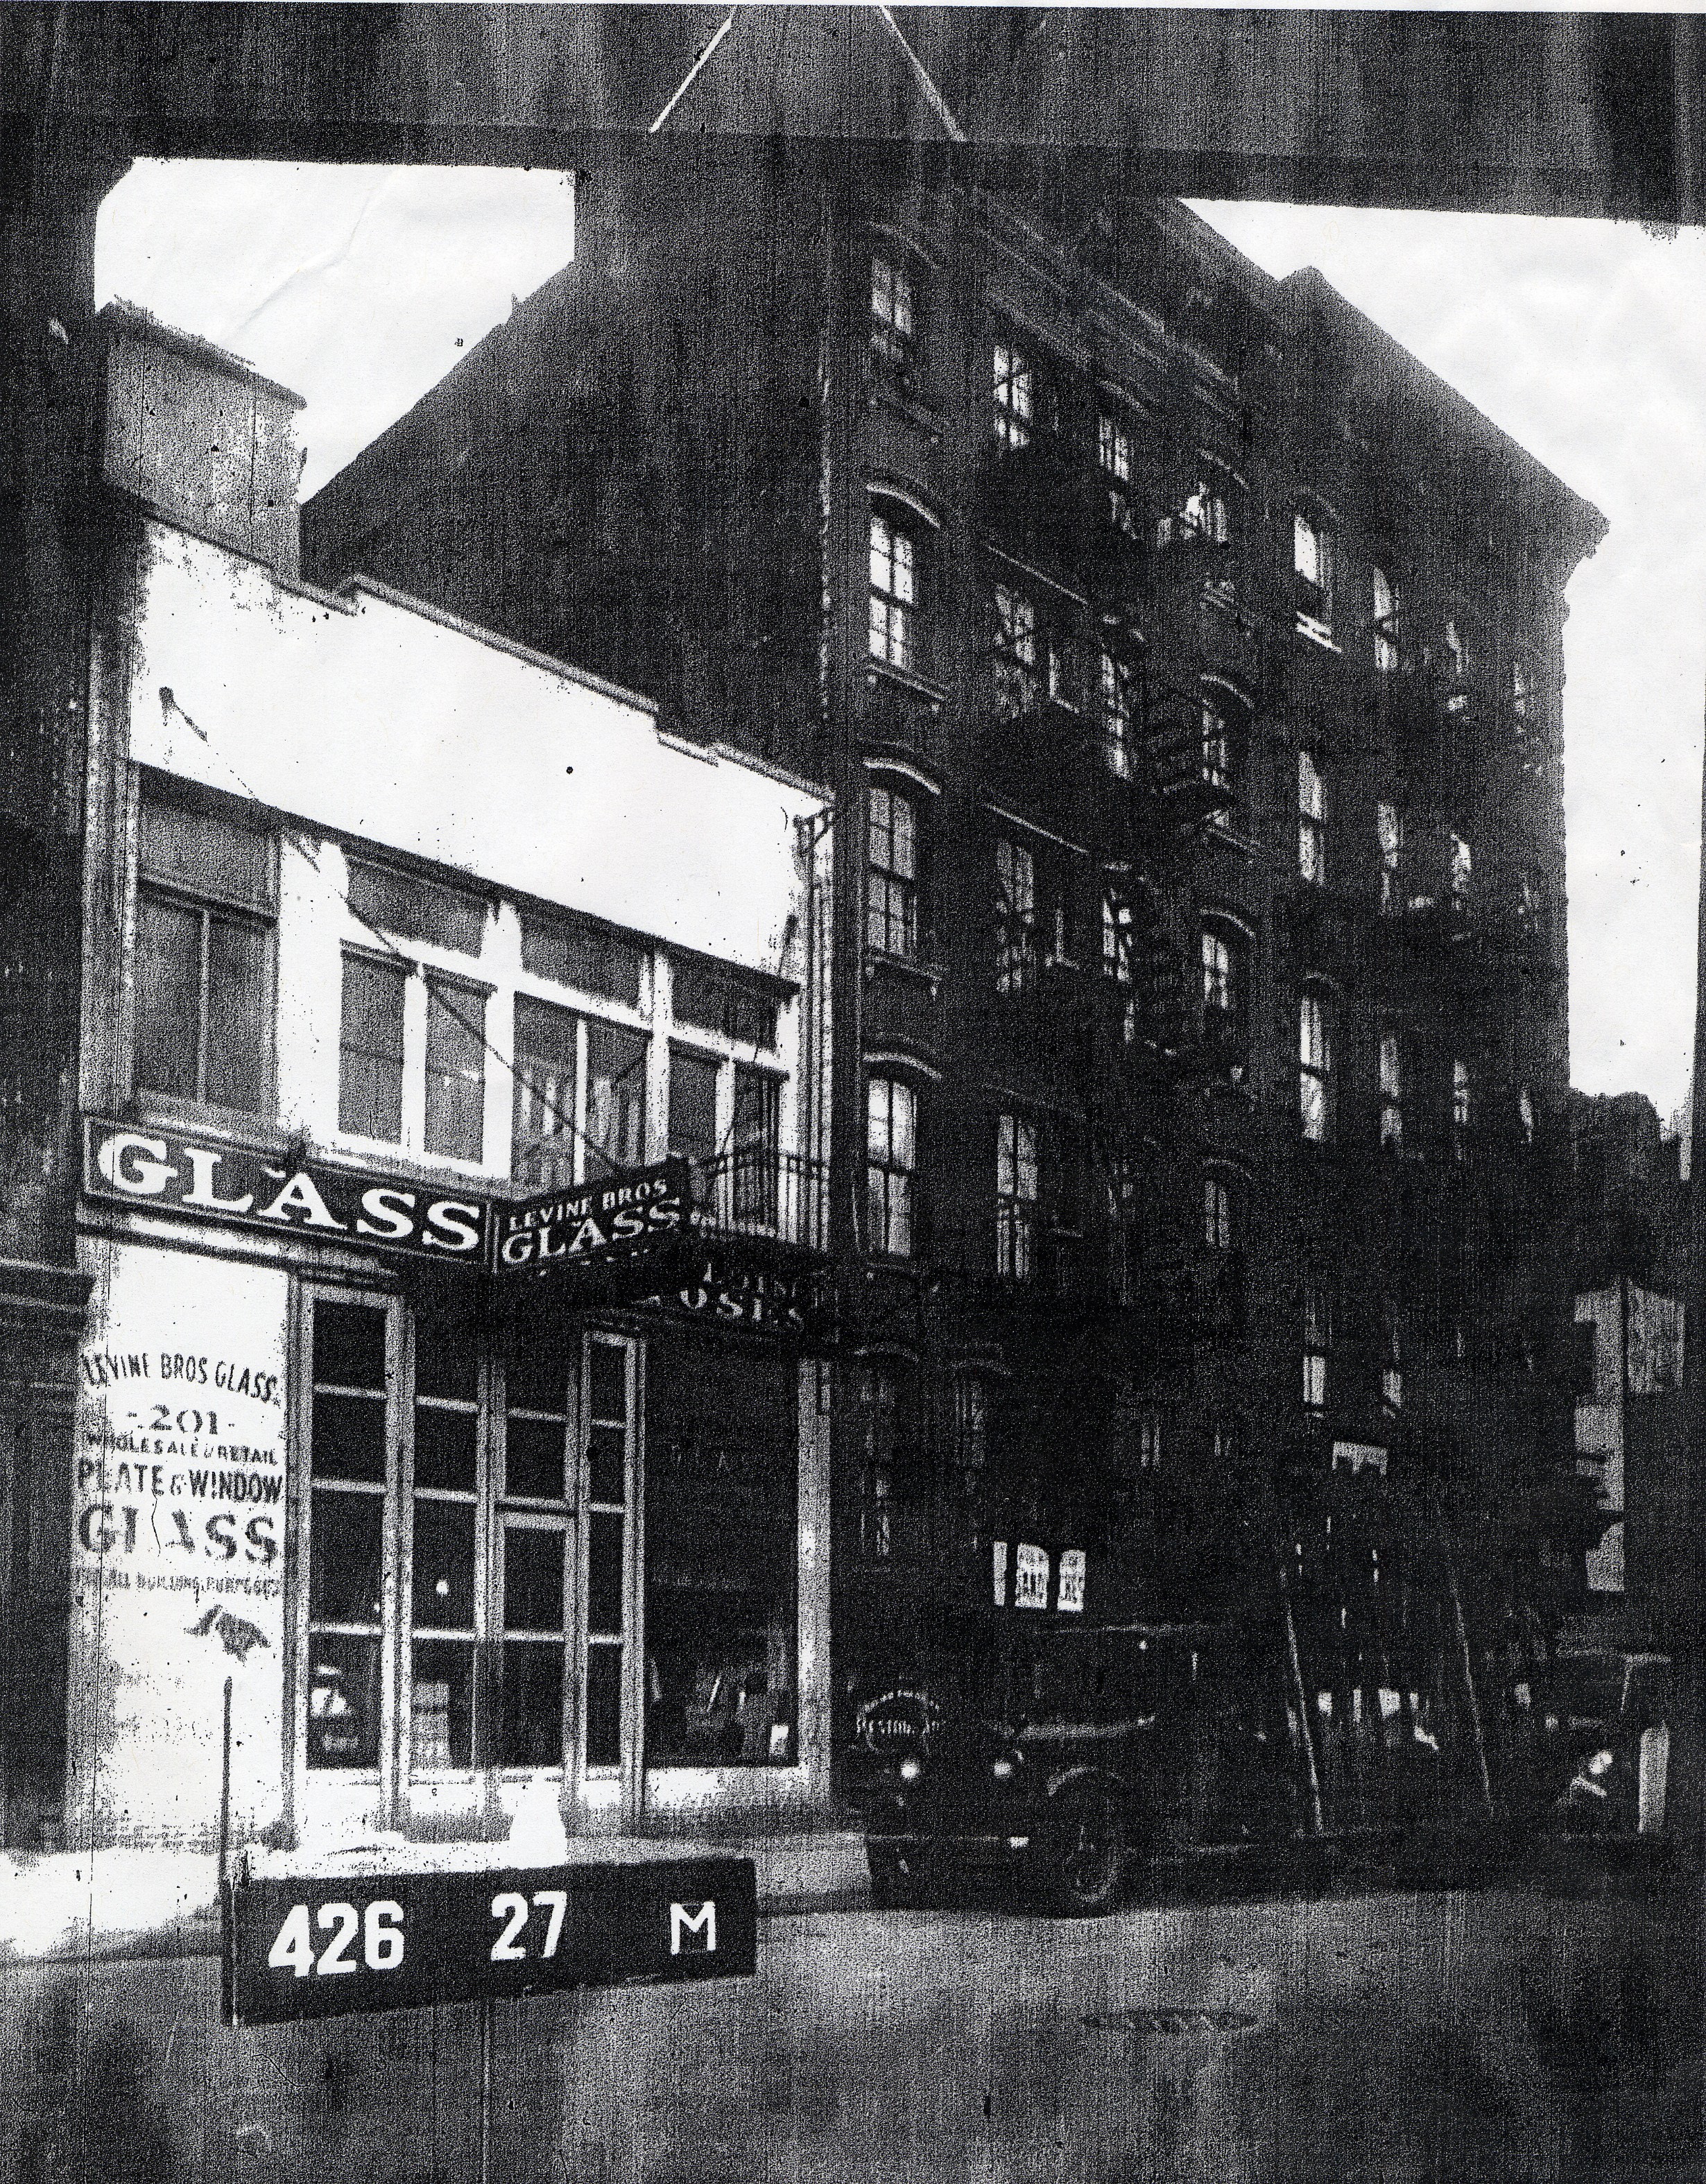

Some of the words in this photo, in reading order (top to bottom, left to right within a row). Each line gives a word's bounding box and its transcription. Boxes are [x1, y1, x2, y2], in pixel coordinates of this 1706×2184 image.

[98, 1133, 479, 1250] GLASS
[510, 1196, 592, 1230] LEVINE
[603, 1179, 666, 1210] BROS
[502, 1197, 680, 1264] GLASS
[85, 1352, 148, 1388] LEVINE
[160, 1352, 208, 1384] BROS
[189, 1469, 282, 1504] WINDOW
[268, 1900, 404, 1977] 426
[491, 1890, 567, 1961] 27
[670, 1901, 716, 1954] M
